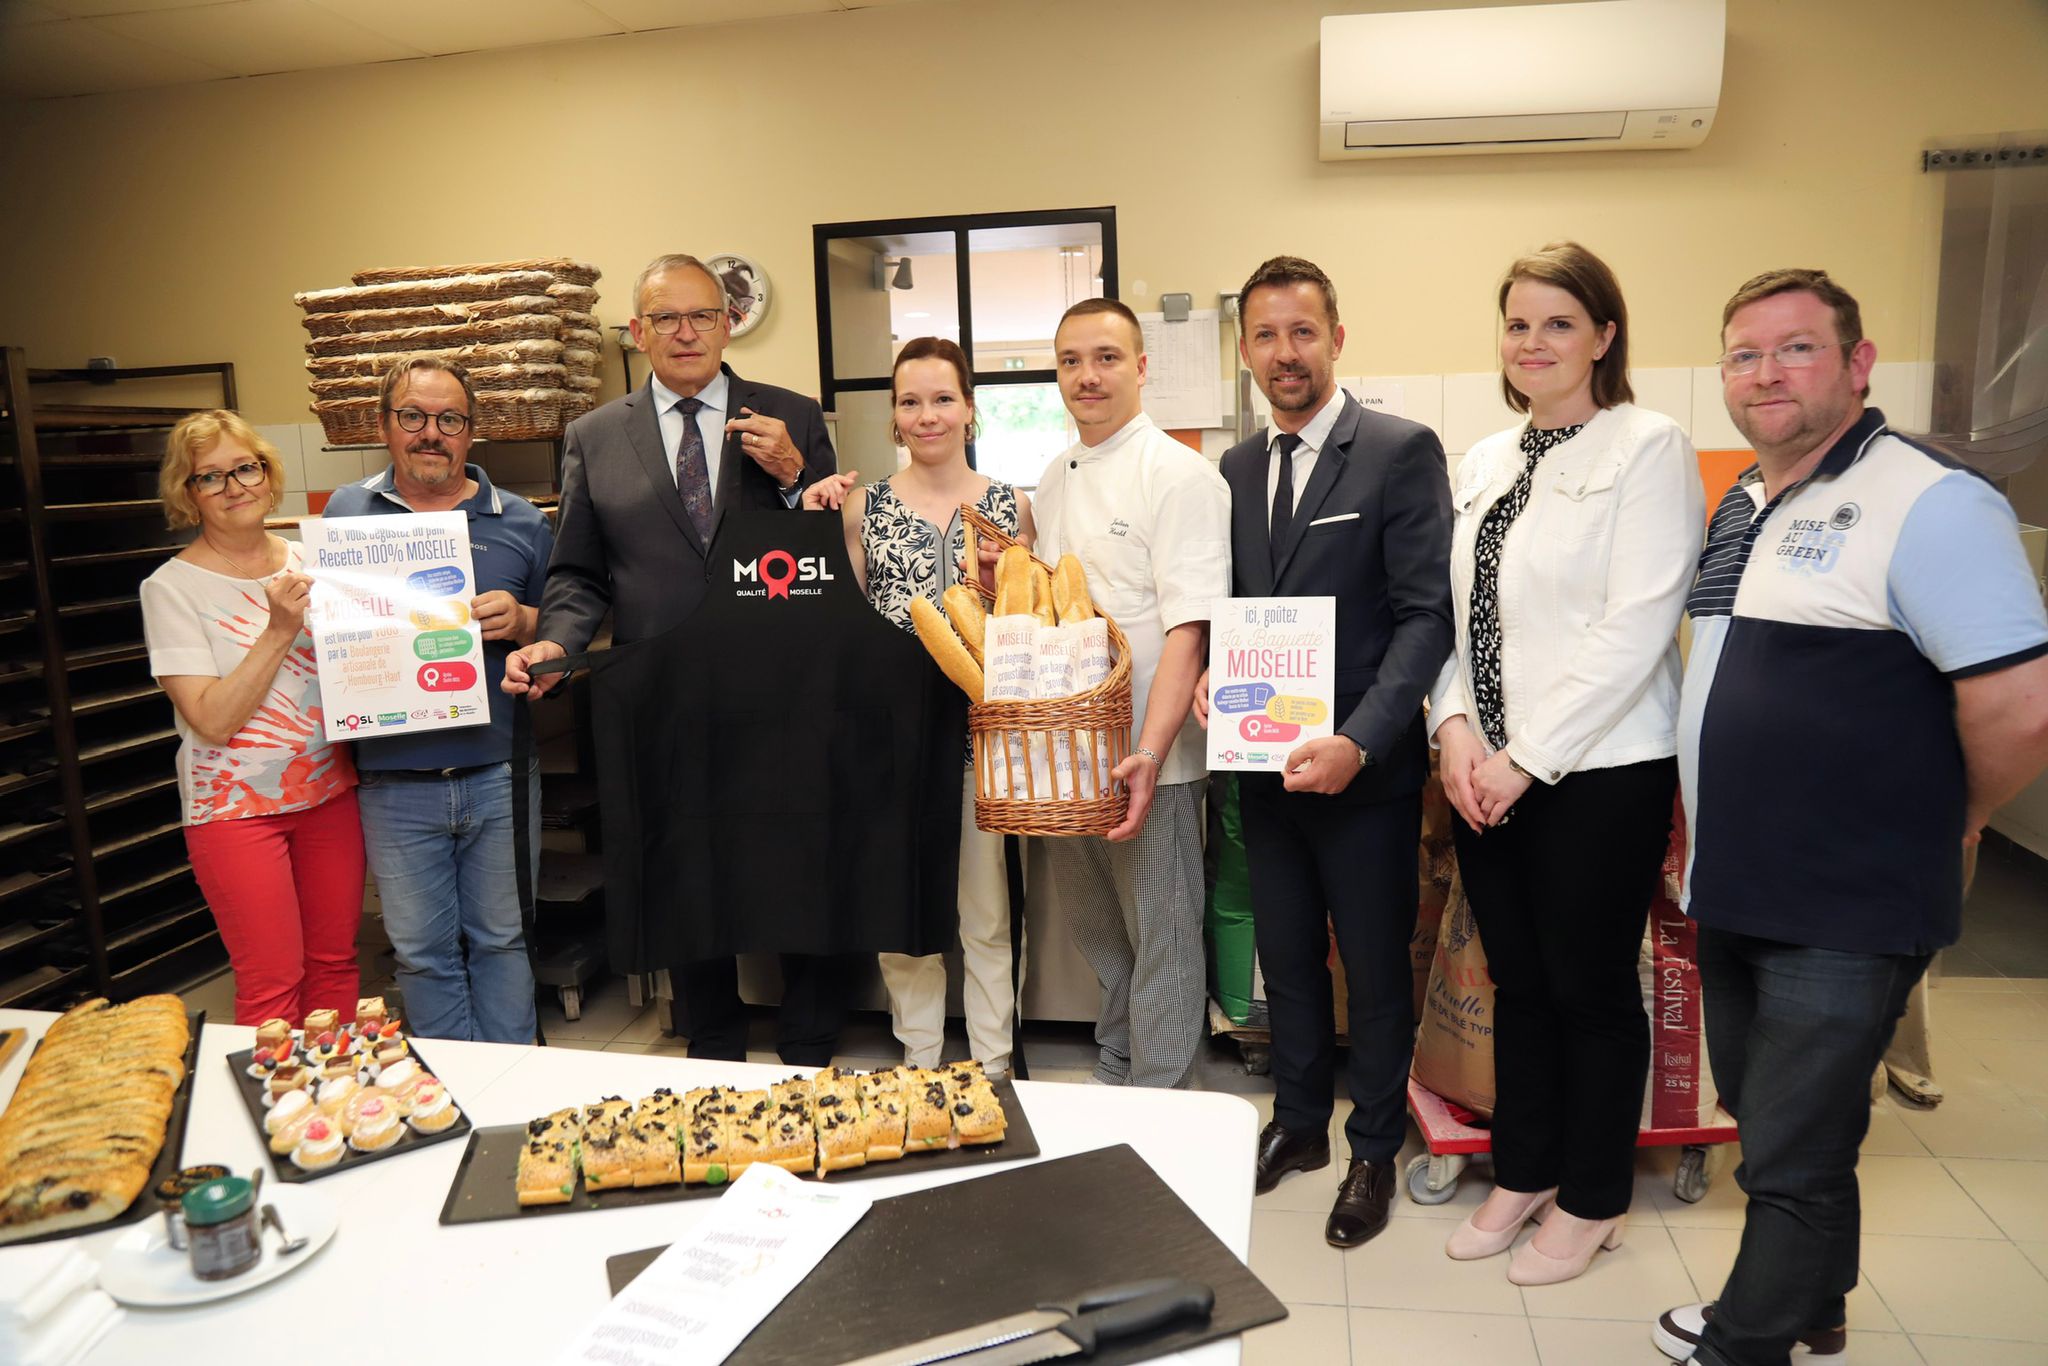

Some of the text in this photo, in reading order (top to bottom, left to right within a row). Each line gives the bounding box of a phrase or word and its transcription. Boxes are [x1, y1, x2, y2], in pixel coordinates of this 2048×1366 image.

[727, 260, 736, 269] 12
[757, 293, 764, 302] 3
[1788, 519, 1827, 532] MISE
[1781, 532, 1803, 543] AU
[318, 538, 458, 568] Recette 100% MOSELLE
[1776, 545, 1828, 561] GREEN
[733, 550, 835, 590] MOSL
[736, 588, 822, 597] QUALITÉ MOSELLE
[1245, 605, 1298, 629] ici, goûtez
[996, 631, 1033, 647] MOSELLE
[1247, 628, 1324, 653] Baguette
[327, 643, 391, 663] par la Boulangerie
[1040, 643, 1077, 658] MOSELLE
[1004, 651, 1033, 667] baguette
[1227, 648, 1318, 678] MOSELLE
[336, 714, 374, 730] MOSL
[1217, 750, 1244, 762] MOSL
[1659, 919, 1687, 946] La
[1662, 955, 1692, 1031] Festival
[1665, 1079, 1691, 1090] 25 kg
